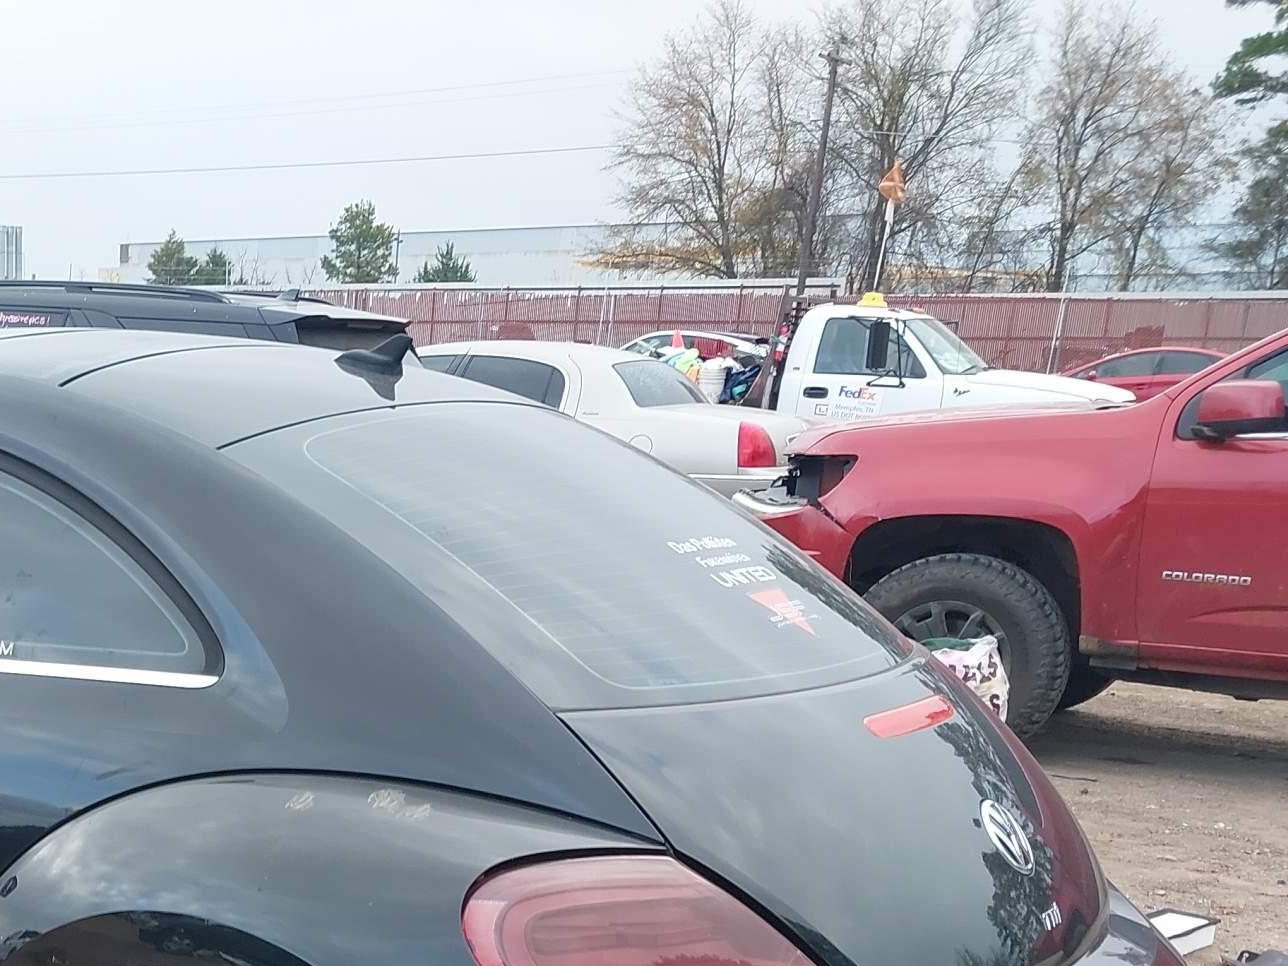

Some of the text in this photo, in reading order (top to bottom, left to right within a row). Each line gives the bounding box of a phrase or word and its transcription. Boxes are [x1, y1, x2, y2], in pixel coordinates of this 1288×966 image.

[838, 385, 877, 401] FedEx
[710, 566, 777, 587] UNITED
[1161, 570, 1253, 586] COLORADO
